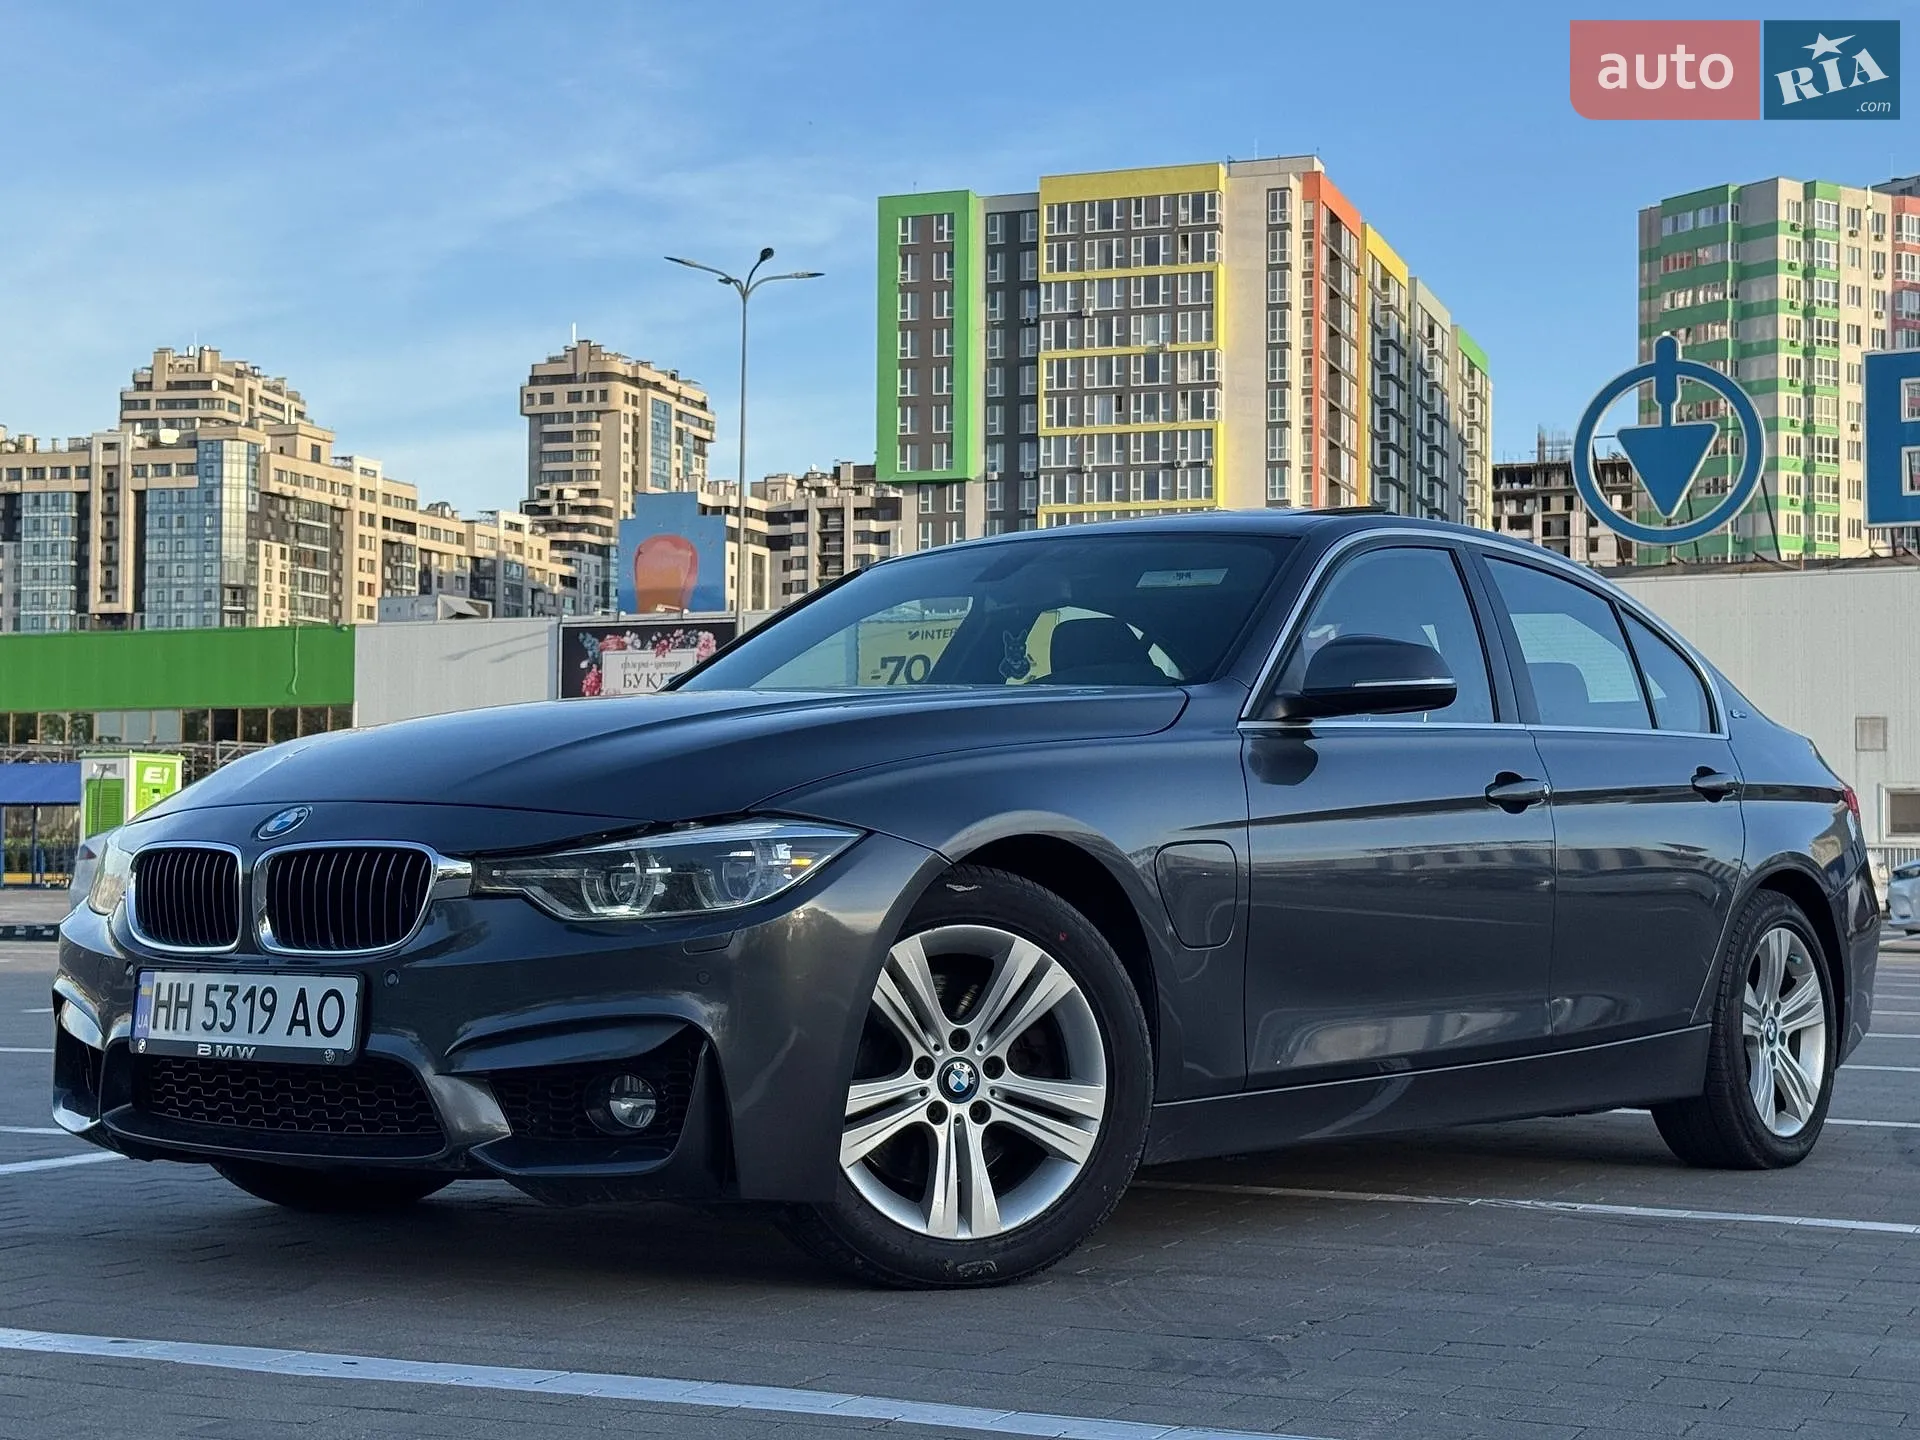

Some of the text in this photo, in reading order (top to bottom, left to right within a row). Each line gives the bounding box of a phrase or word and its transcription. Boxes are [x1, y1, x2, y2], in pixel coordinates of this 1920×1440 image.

[152, 982, 346, 1038] HH 5319 AO
[137, 1013, 149, 1029] UA
[197, 1043, 257, 1059] BMW
